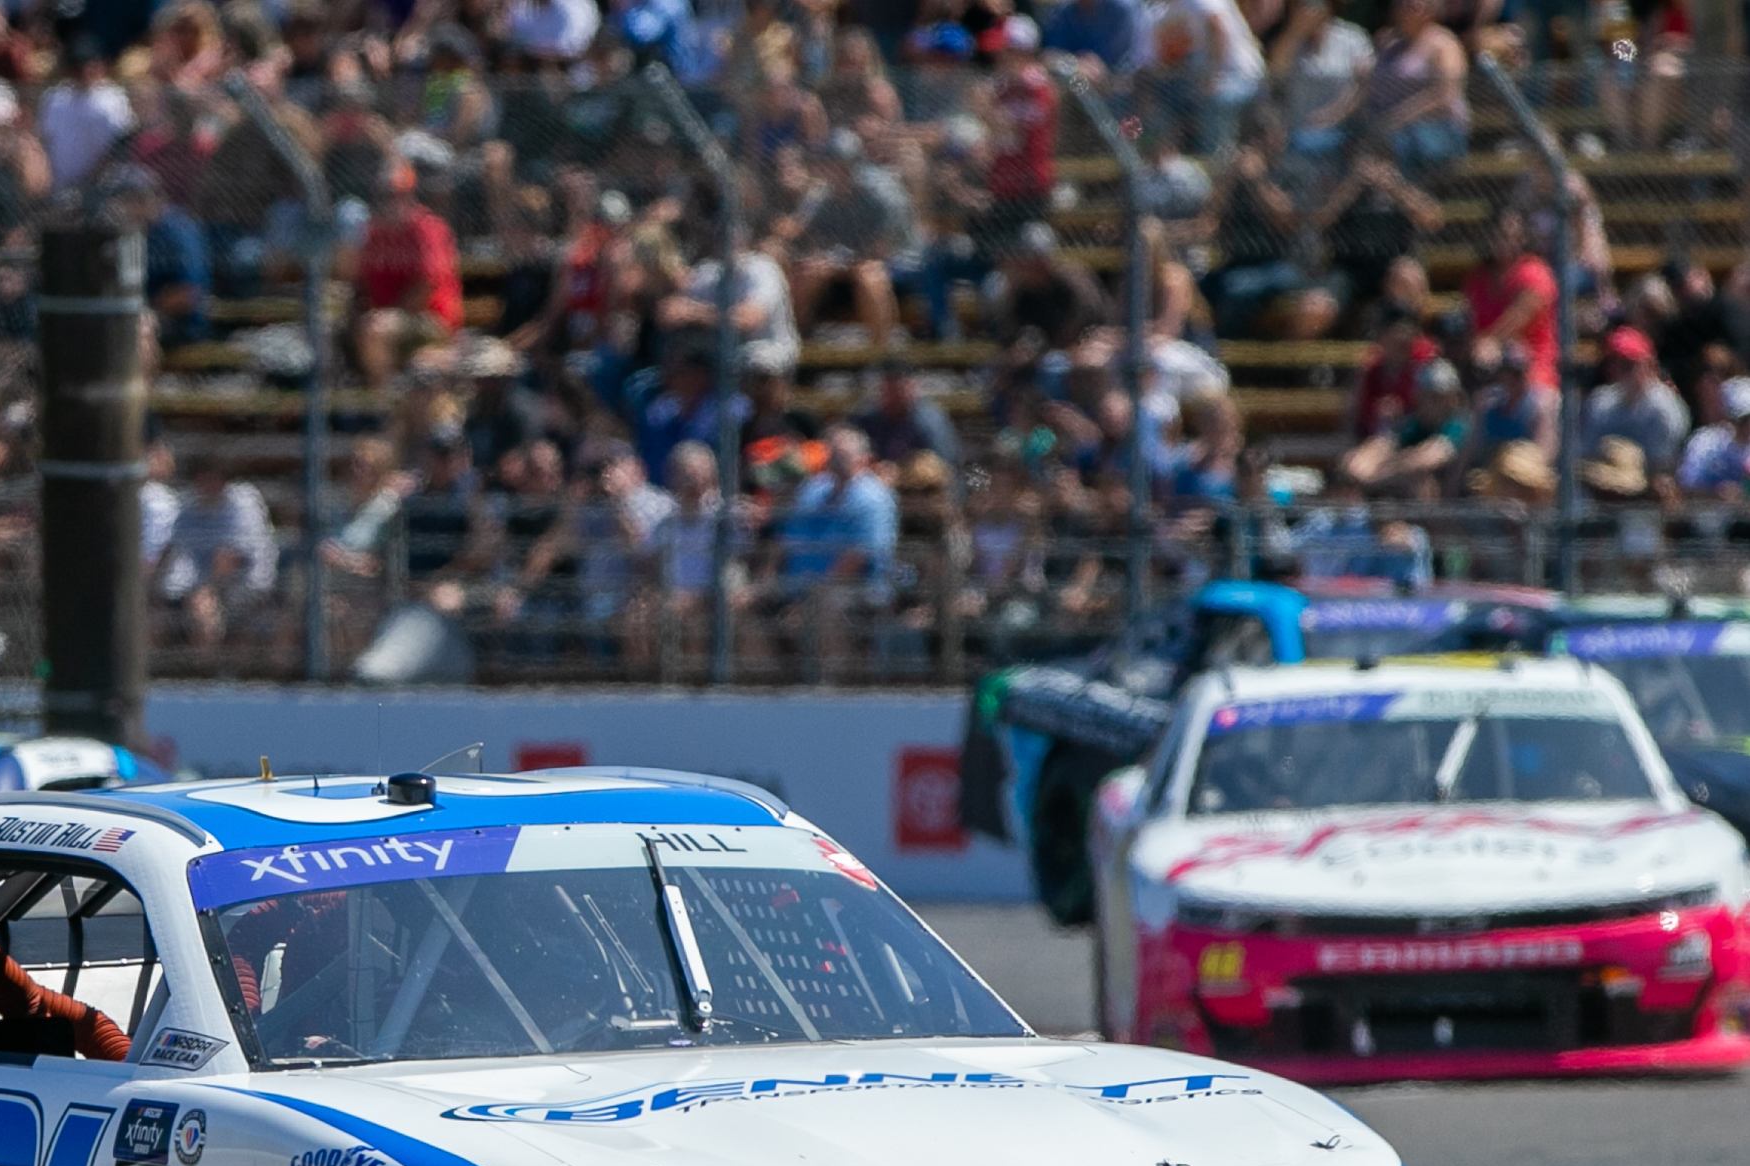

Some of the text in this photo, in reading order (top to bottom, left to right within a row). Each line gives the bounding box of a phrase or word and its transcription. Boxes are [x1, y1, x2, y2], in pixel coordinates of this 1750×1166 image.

[49, 822, 103, 850] HILL
[635, 831, 748, 853] HILL
[240, 838, 454, 884] xfinity
[151, 1048, 200, 1064] RACE CAR
[172, 1034, 213, 1052] NASCAR
[677, 1083, 1024, 1113] TRANSPORTATION
[125, 1118, 164, 1150] xfinity
